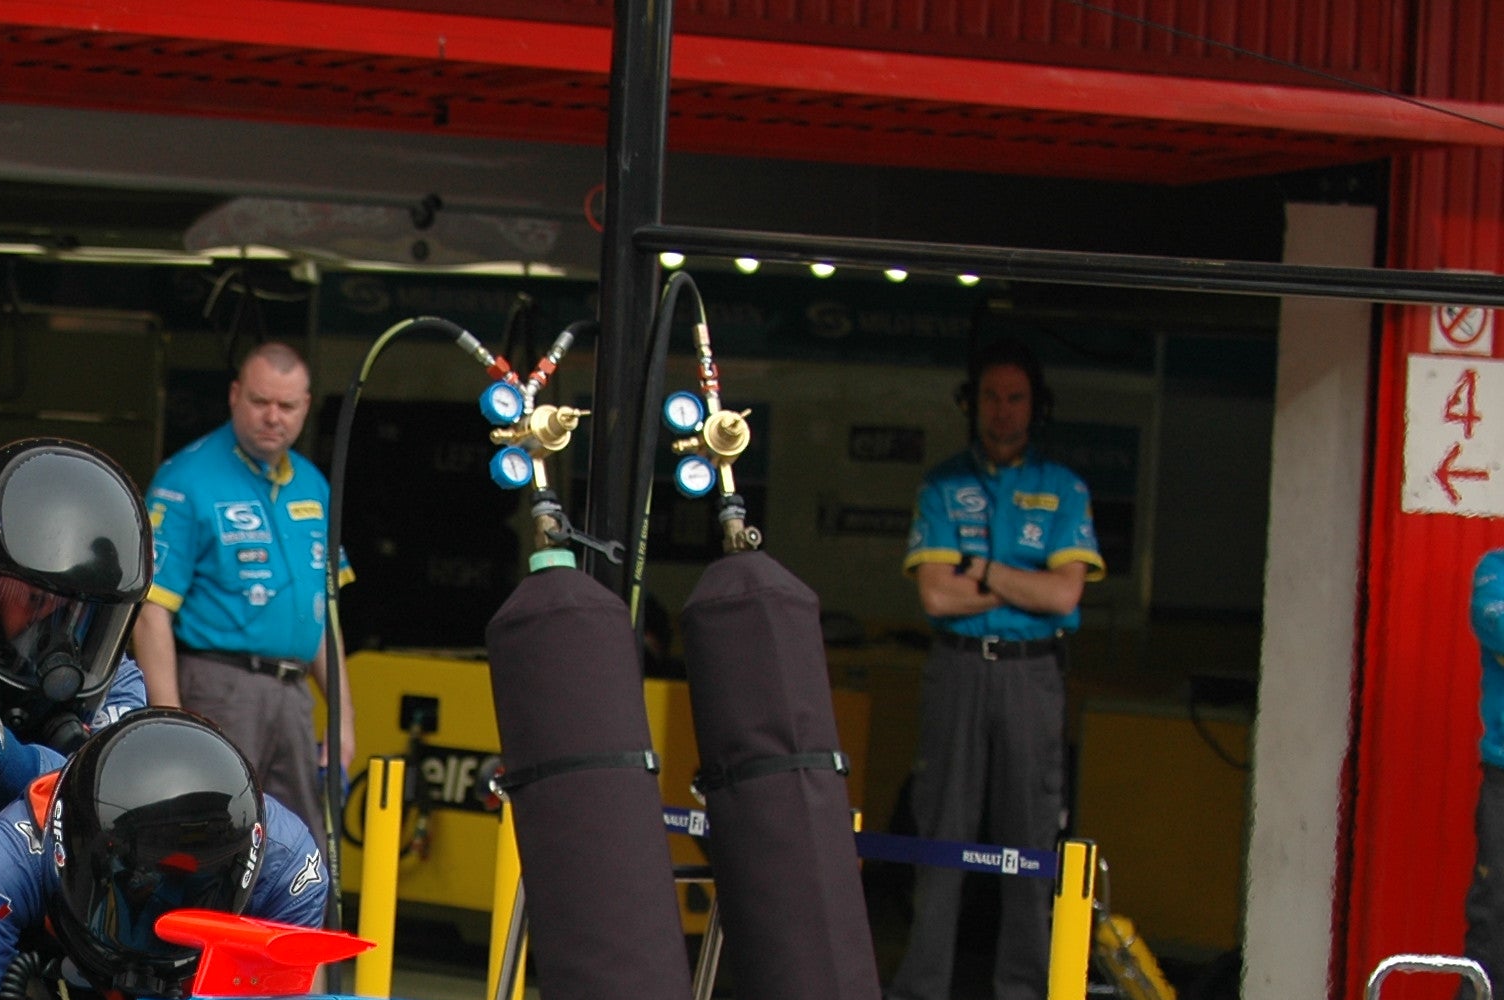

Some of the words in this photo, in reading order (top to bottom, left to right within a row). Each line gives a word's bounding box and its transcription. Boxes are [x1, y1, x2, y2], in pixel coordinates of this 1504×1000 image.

[1443, 369, 1483, 439] 4
[422, 755, 478, 803] elf
[53, 800, 64, 843] elf
[241, 846, 263, 889] elf
[962, 849, 1002, 867] RENAULT
[1019, 857, 1040, 870] Team
